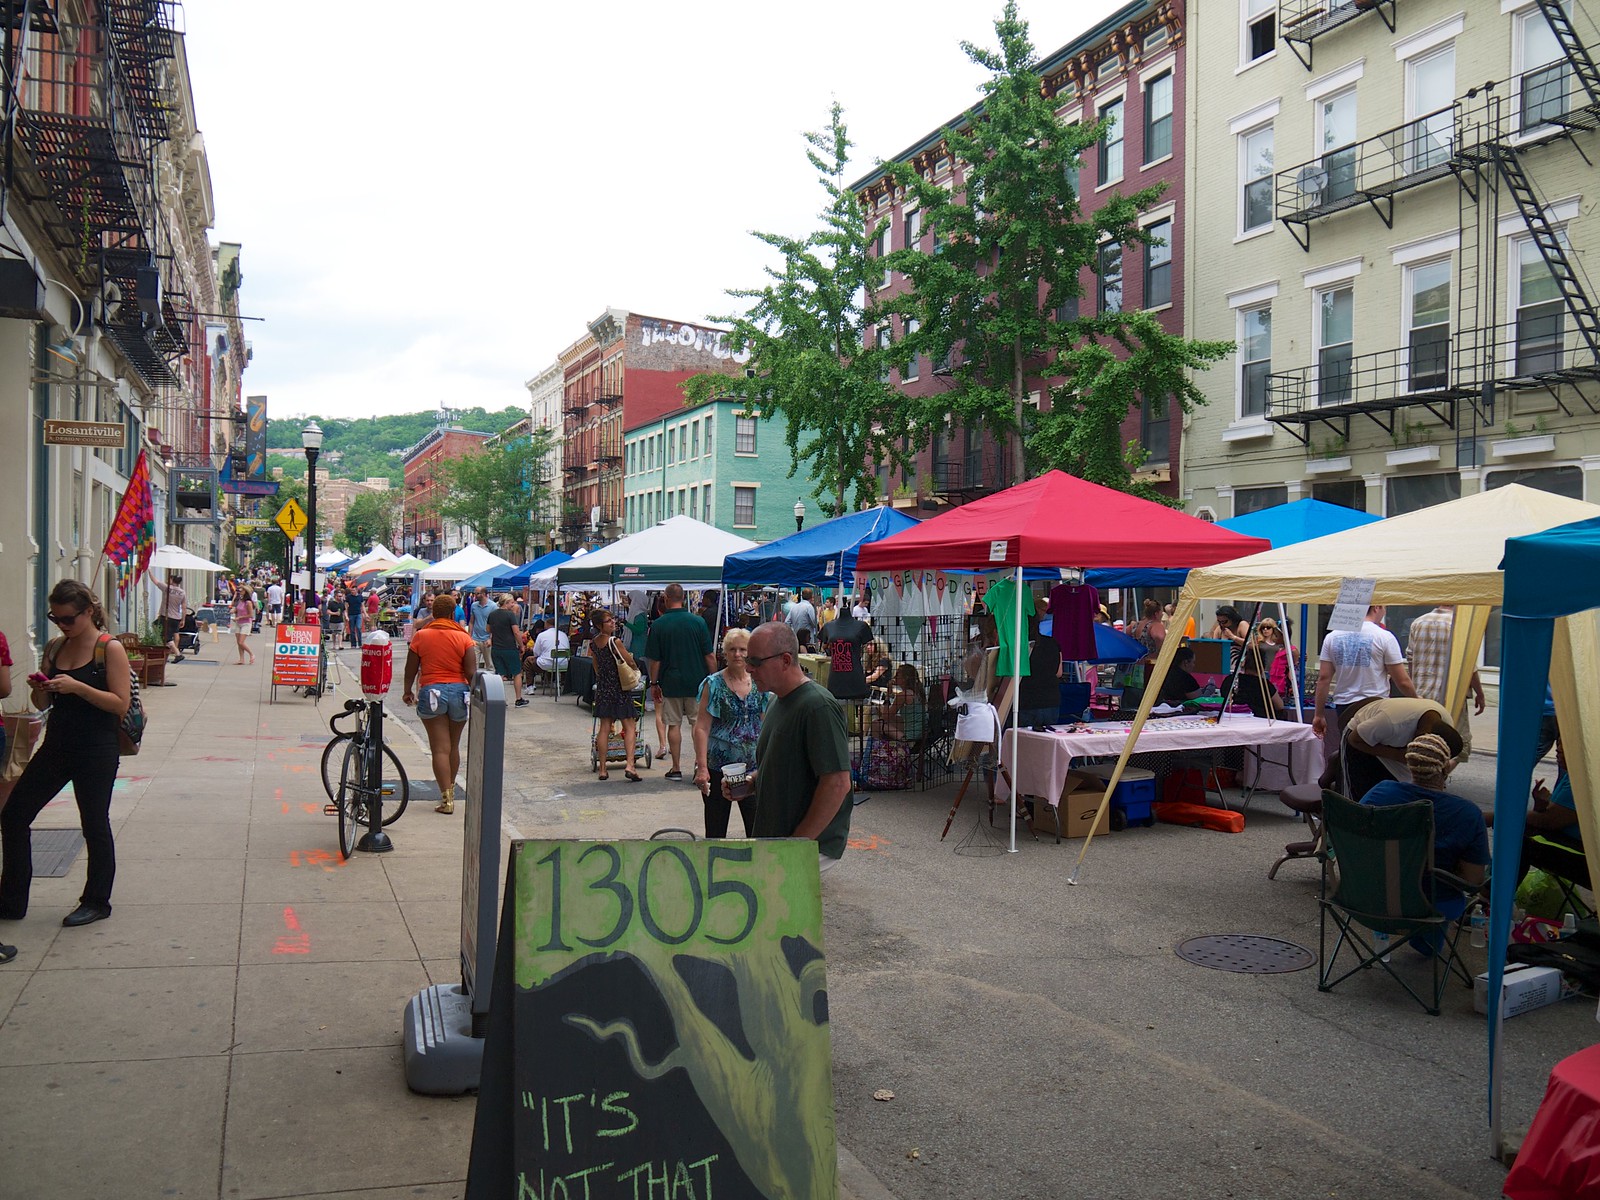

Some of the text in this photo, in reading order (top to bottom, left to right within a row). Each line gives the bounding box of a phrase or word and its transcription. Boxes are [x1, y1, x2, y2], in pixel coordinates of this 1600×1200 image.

[48, 424, 121, 437] Losantiville
[858, 570, 912, 590] HODGE
[285, 630, 313, 638] URBAN
[279, 644, 317, 655] OPEN
[831, 642, 852, 655] HOT
[536, 844, 759, 952] 1305
[522, 1090, 639, 1154] "IT'S
[517, 1154, 719, 1200] NOT THAT
